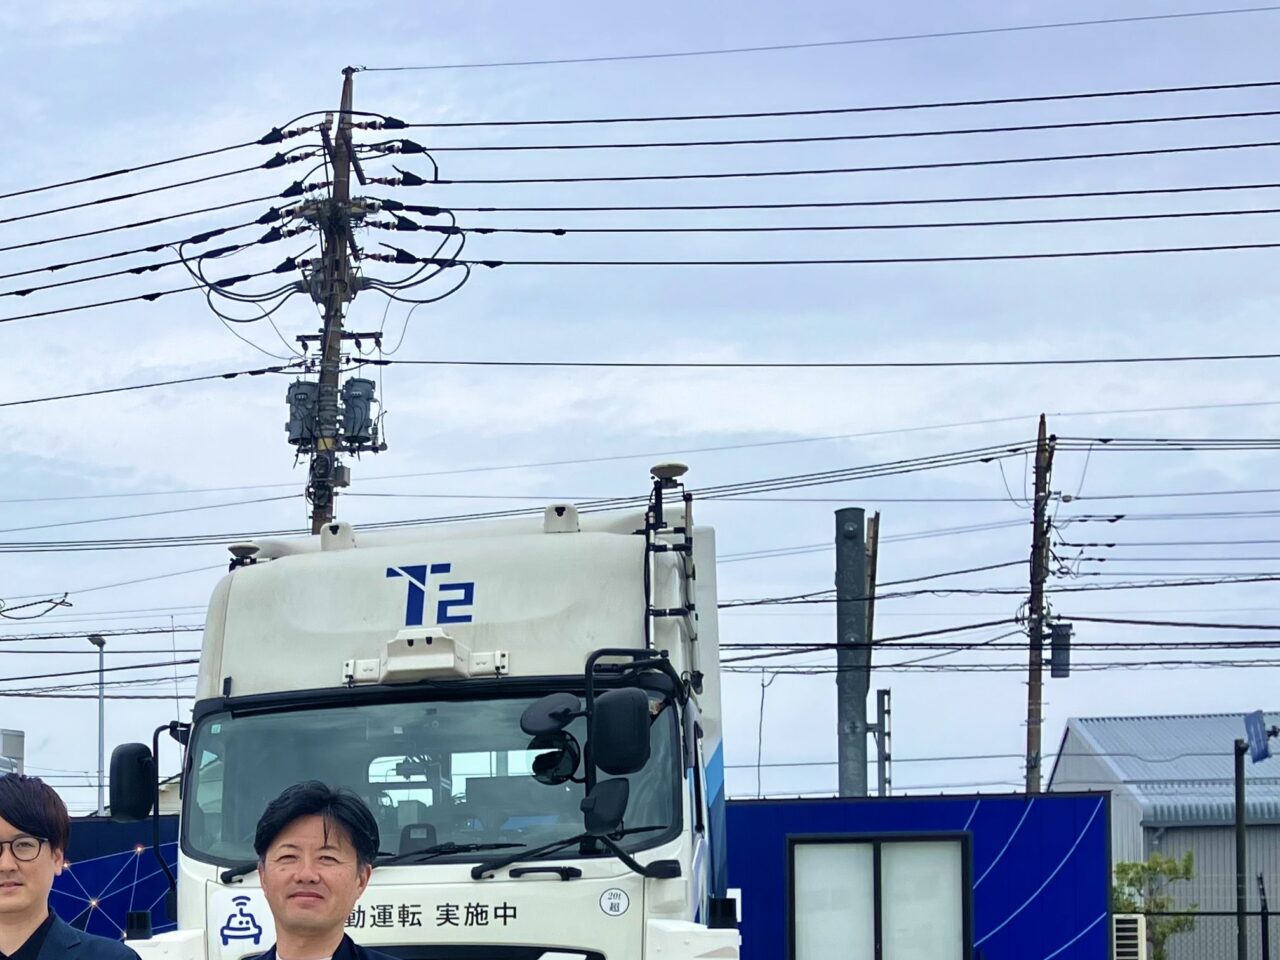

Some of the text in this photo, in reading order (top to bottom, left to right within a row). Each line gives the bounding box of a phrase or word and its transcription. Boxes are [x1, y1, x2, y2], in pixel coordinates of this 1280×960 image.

[386, 563, 474, 626] T2
[435, 901, 518, 927] 実施中
